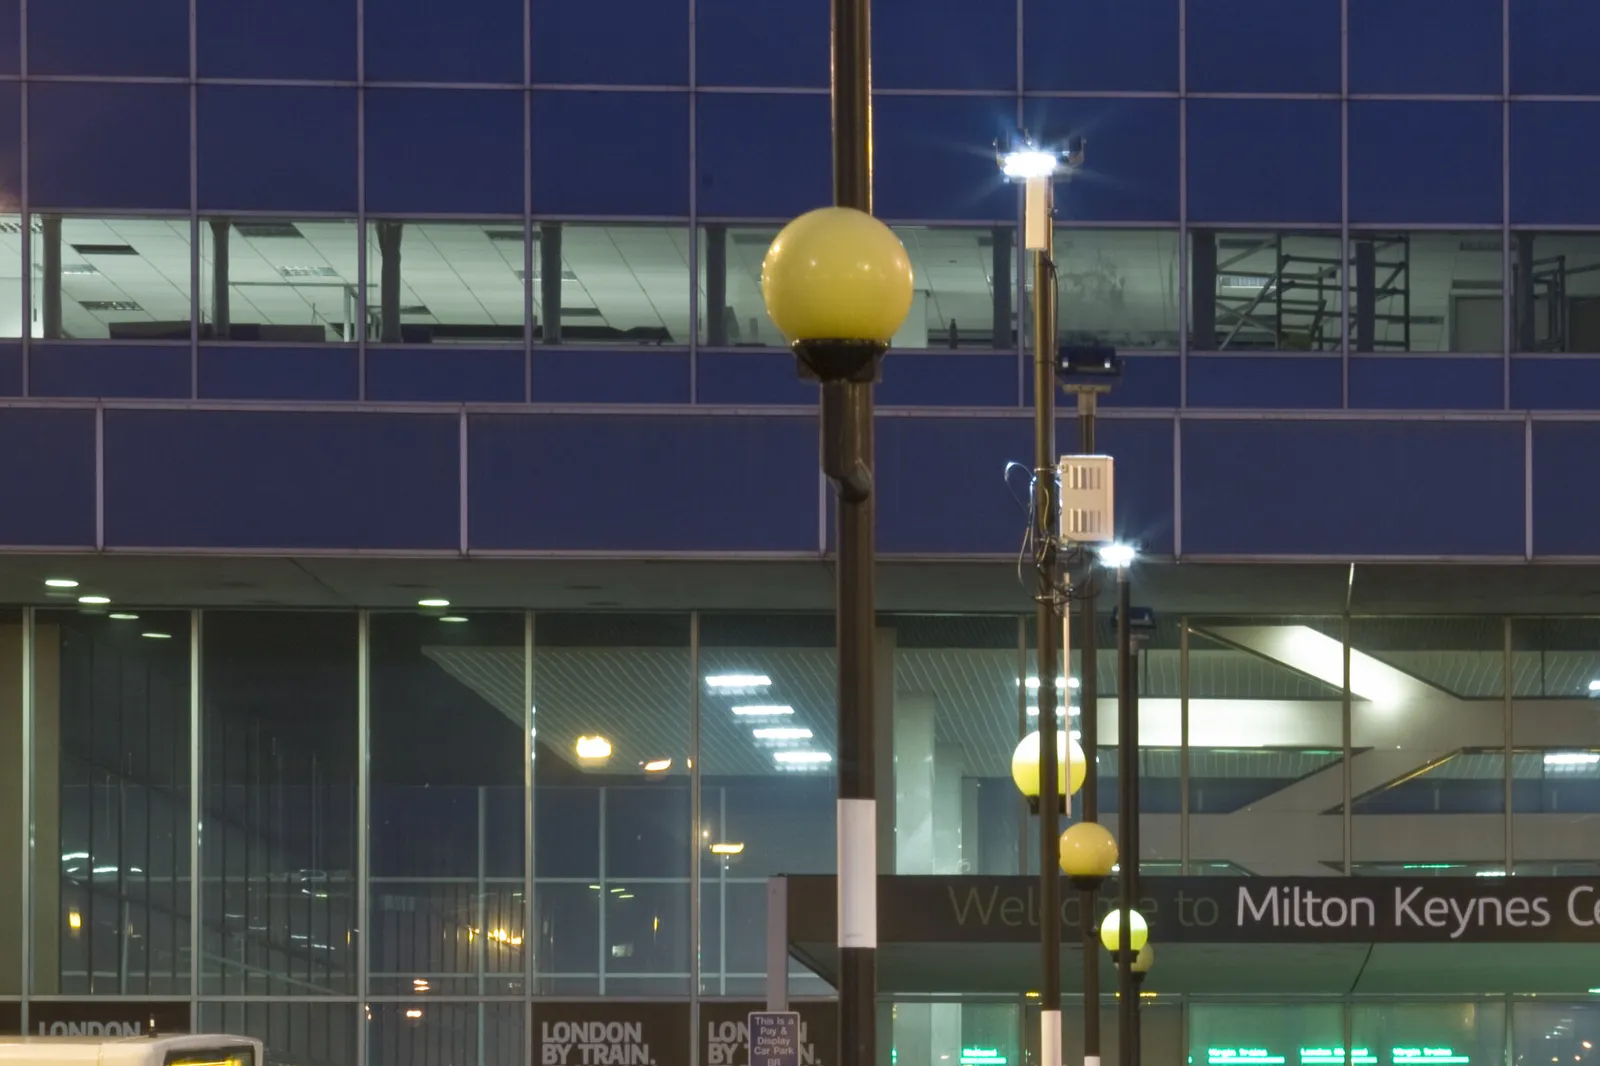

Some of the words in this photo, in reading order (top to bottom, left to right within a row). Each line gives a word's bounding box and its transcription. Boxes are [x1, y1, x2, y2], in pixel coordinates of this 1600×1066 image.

[1177, 889, 1220, 927] to
[1237, 884, 1375, 928] Milton
[1394, 885, 1552, 939] Keynes
[755, 1017, 774, 1025] This
[777, 1017, 784, 1025] is
[541, 1021, 642, 1043] LONDON
[761, 1027, 777, 1037] Pay
[757, 1037, 791, 1047] Display
[541, 1044, 572, 1065] BY
[578, 1044, 656, 1065] TRAIN.
[708, 1044, 740, 1065] BY
[754, 1046, 770, 1055] Car
[774, 1046, 795, 1055] Park
